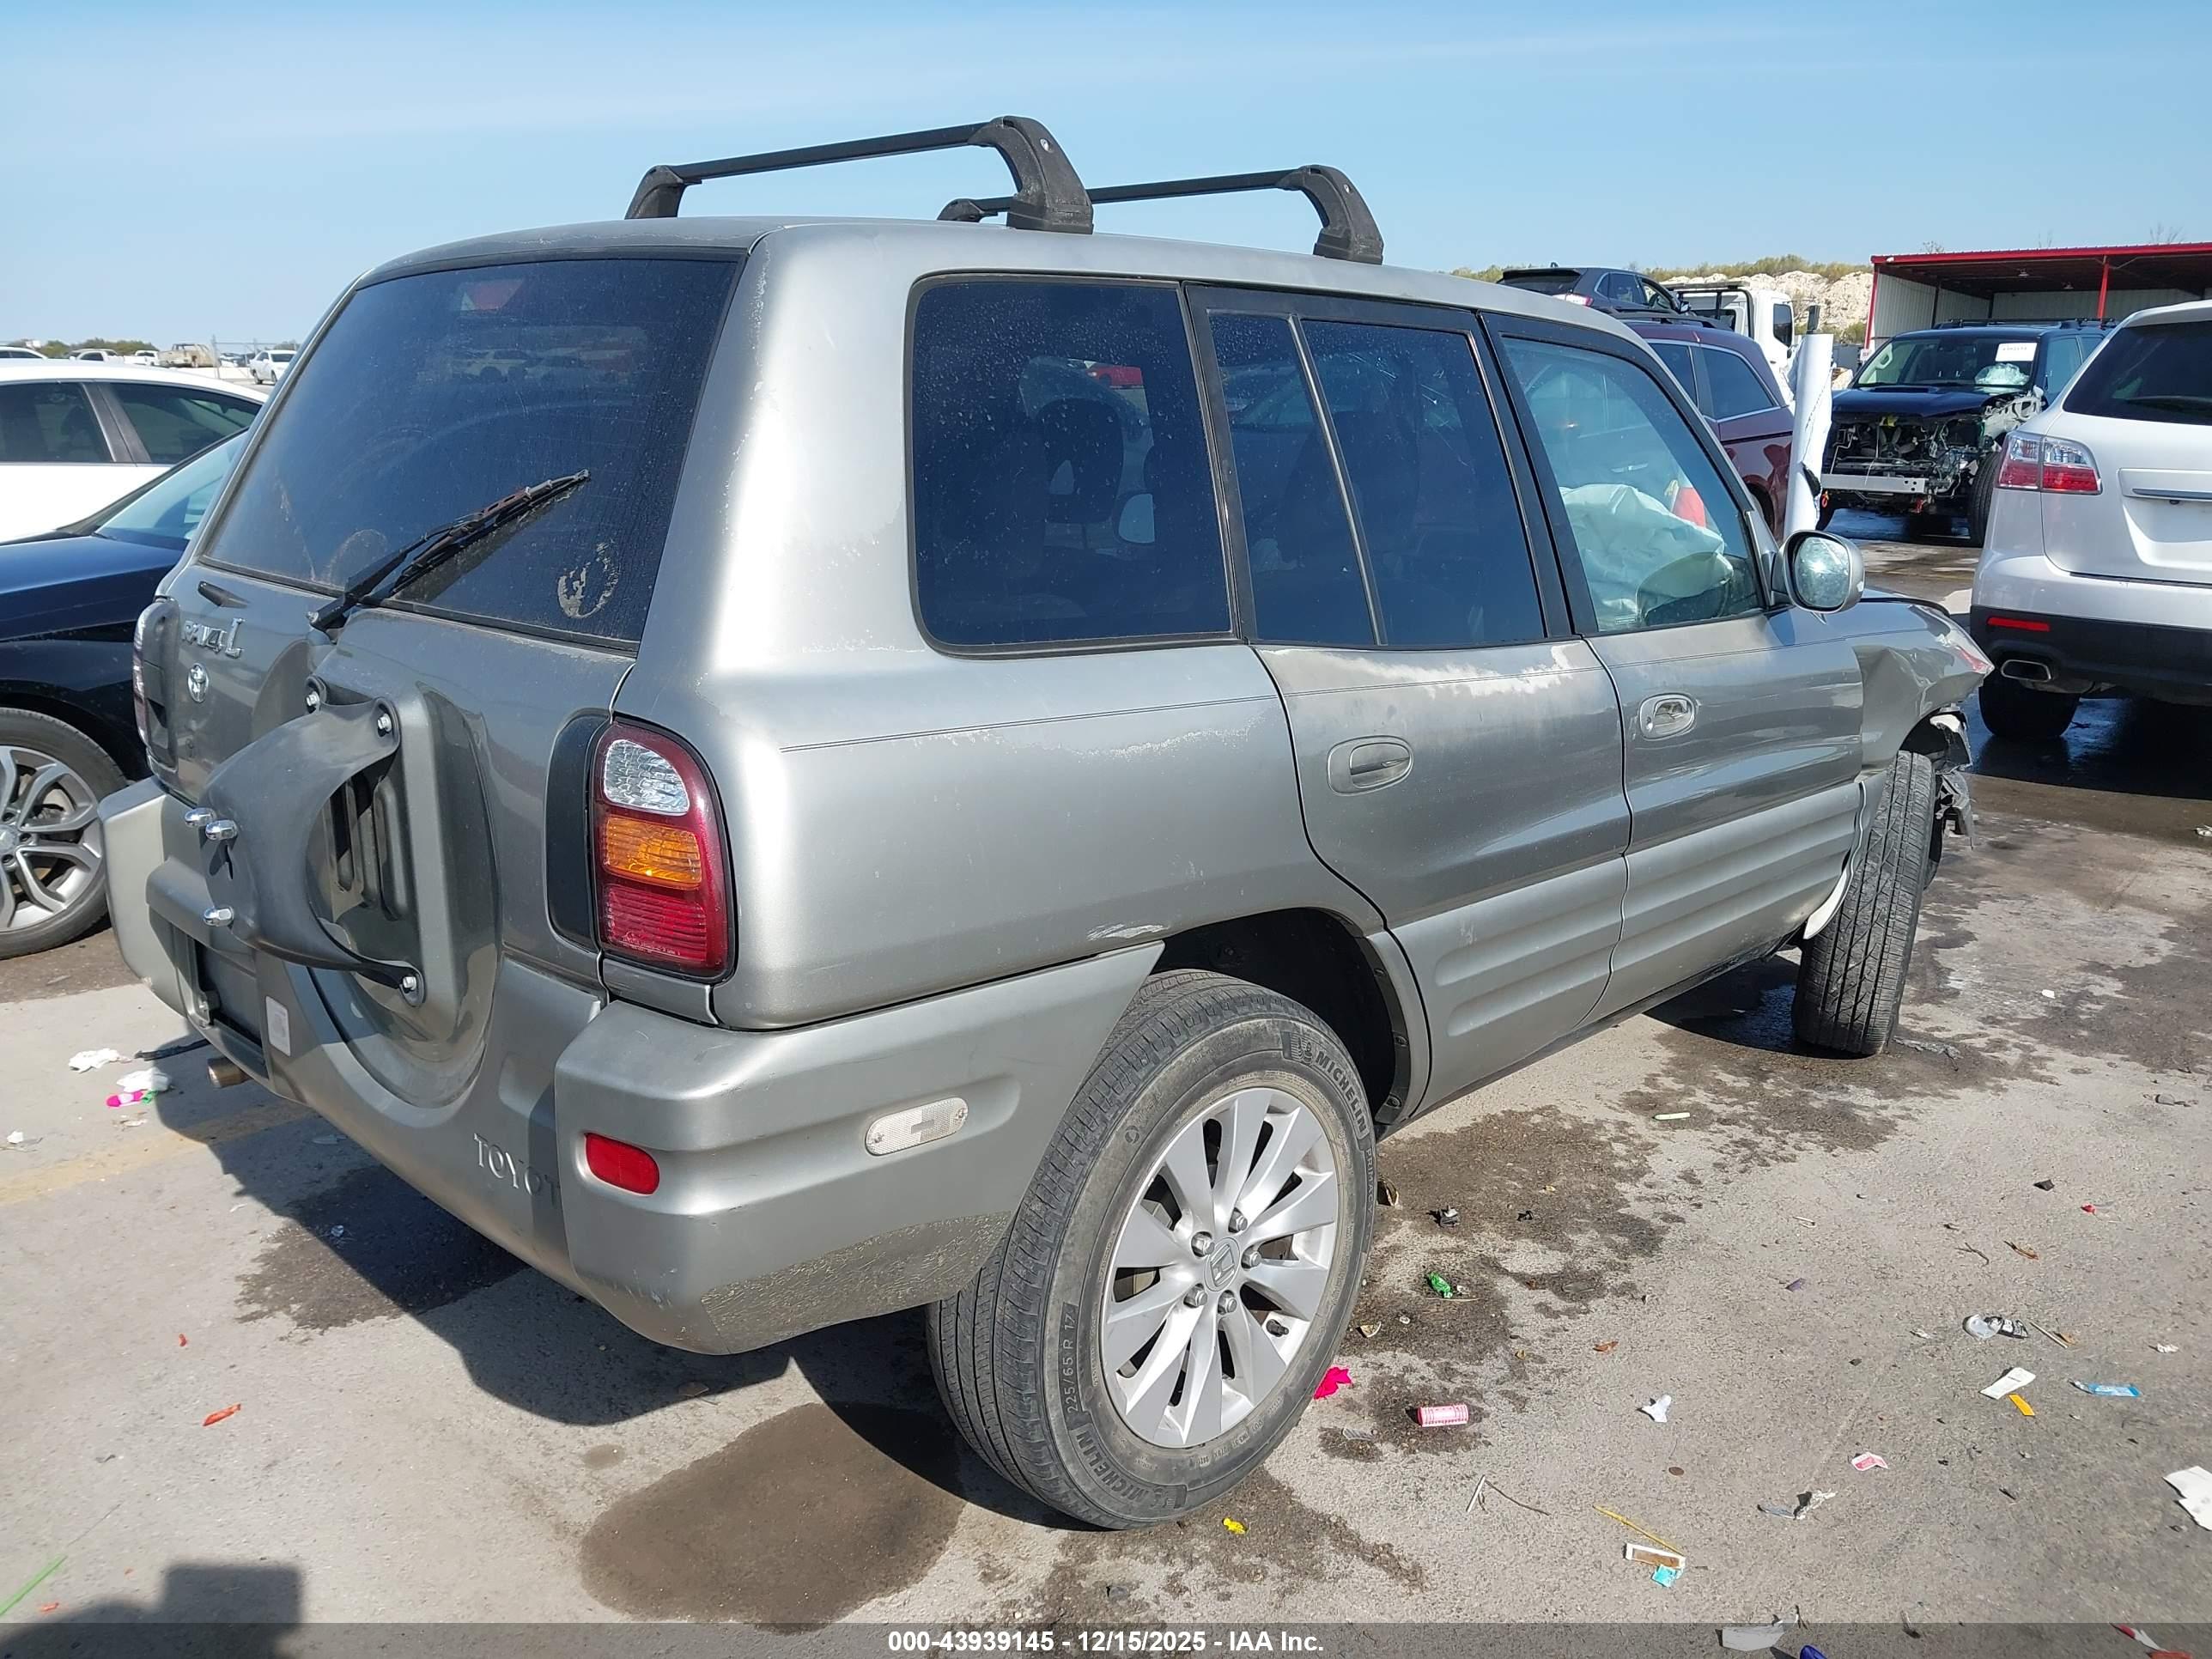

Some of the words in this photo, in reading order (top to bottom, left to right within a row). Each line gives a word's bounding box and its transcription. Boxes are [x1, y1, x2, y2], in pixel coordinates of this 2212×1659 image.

[181, 620, 226, 653] RAV4
[1315, 1049, 1367, 1133] MICHELIN
[473, 1133, 561, 1206] TOYOT
[1365, 1147, 1375, 1214] PRIMACY
[1062, 1339, 1074, 1350] R
[1064, 1313, 1076, 1330] 17
[1062, 1357, 1079, 1413] 225/65
[1076, 1430, 1150, 1503] MICHELIN
